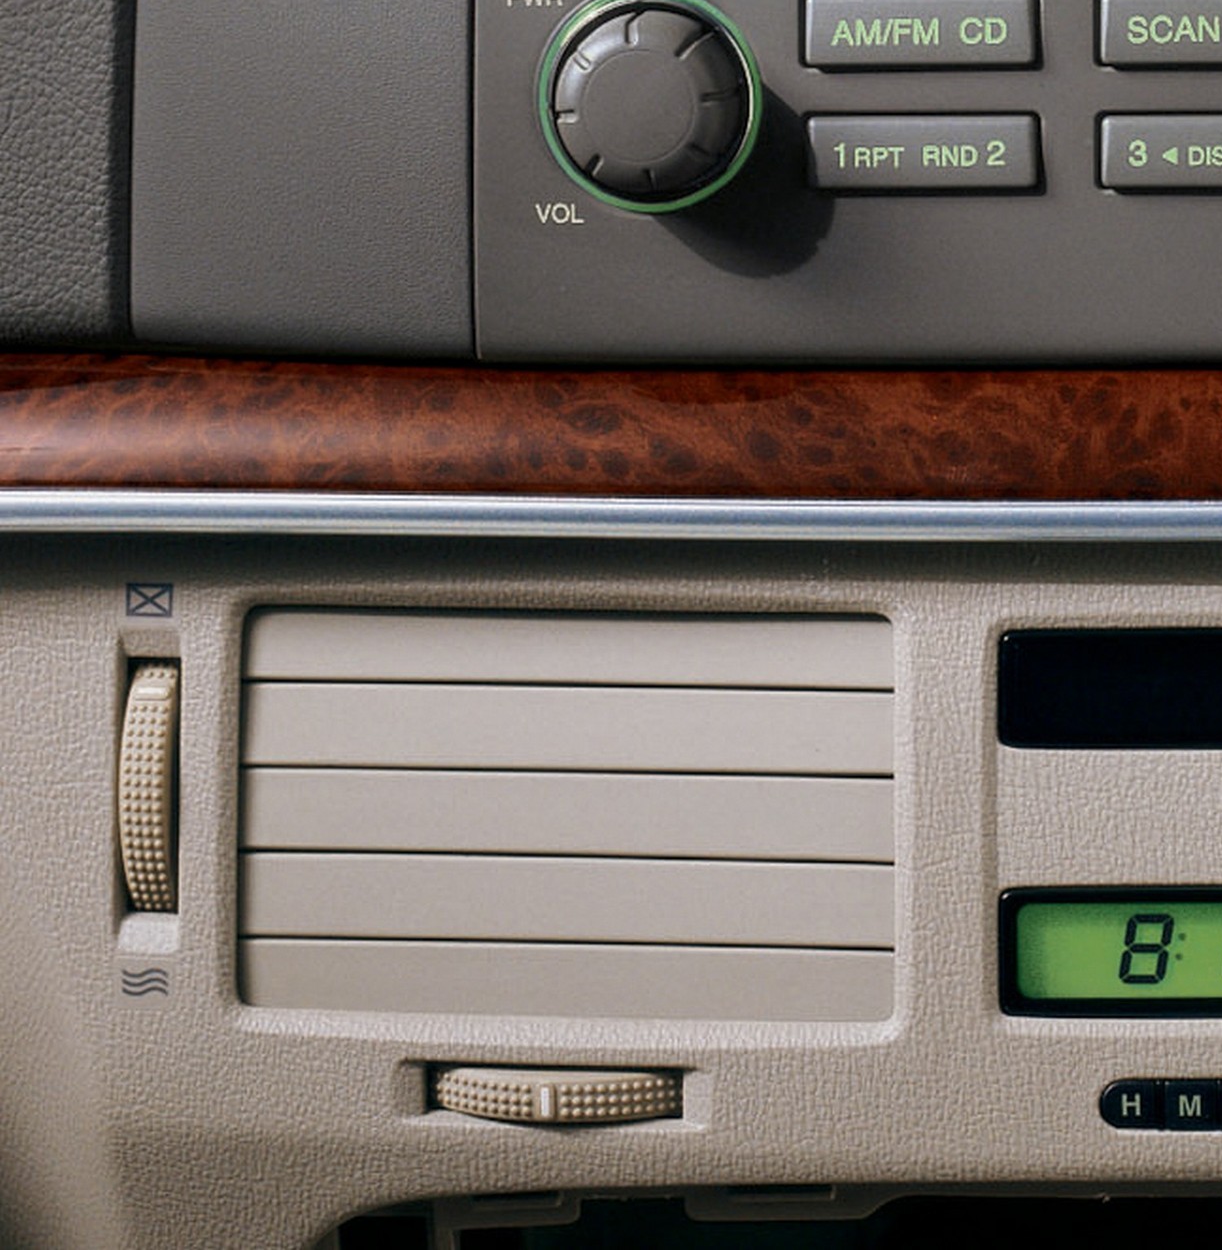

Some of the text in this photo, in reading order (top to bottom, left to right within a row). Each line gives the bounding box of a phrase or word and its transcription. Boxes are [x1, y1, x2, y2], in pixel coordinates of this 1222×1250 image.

[832, 17, 1007, 46] AM/FM CD
[1127, 16, 1220, 44] SCAN
[834, 142, 1005, 168] 1 RPT RND 2
[1128, 140, 1148, 167] 3
[535, 203, 584, 224] VOL
[1121, 1094, 1141, 1116] H
[1179, 1095, 1201, 1116] M
